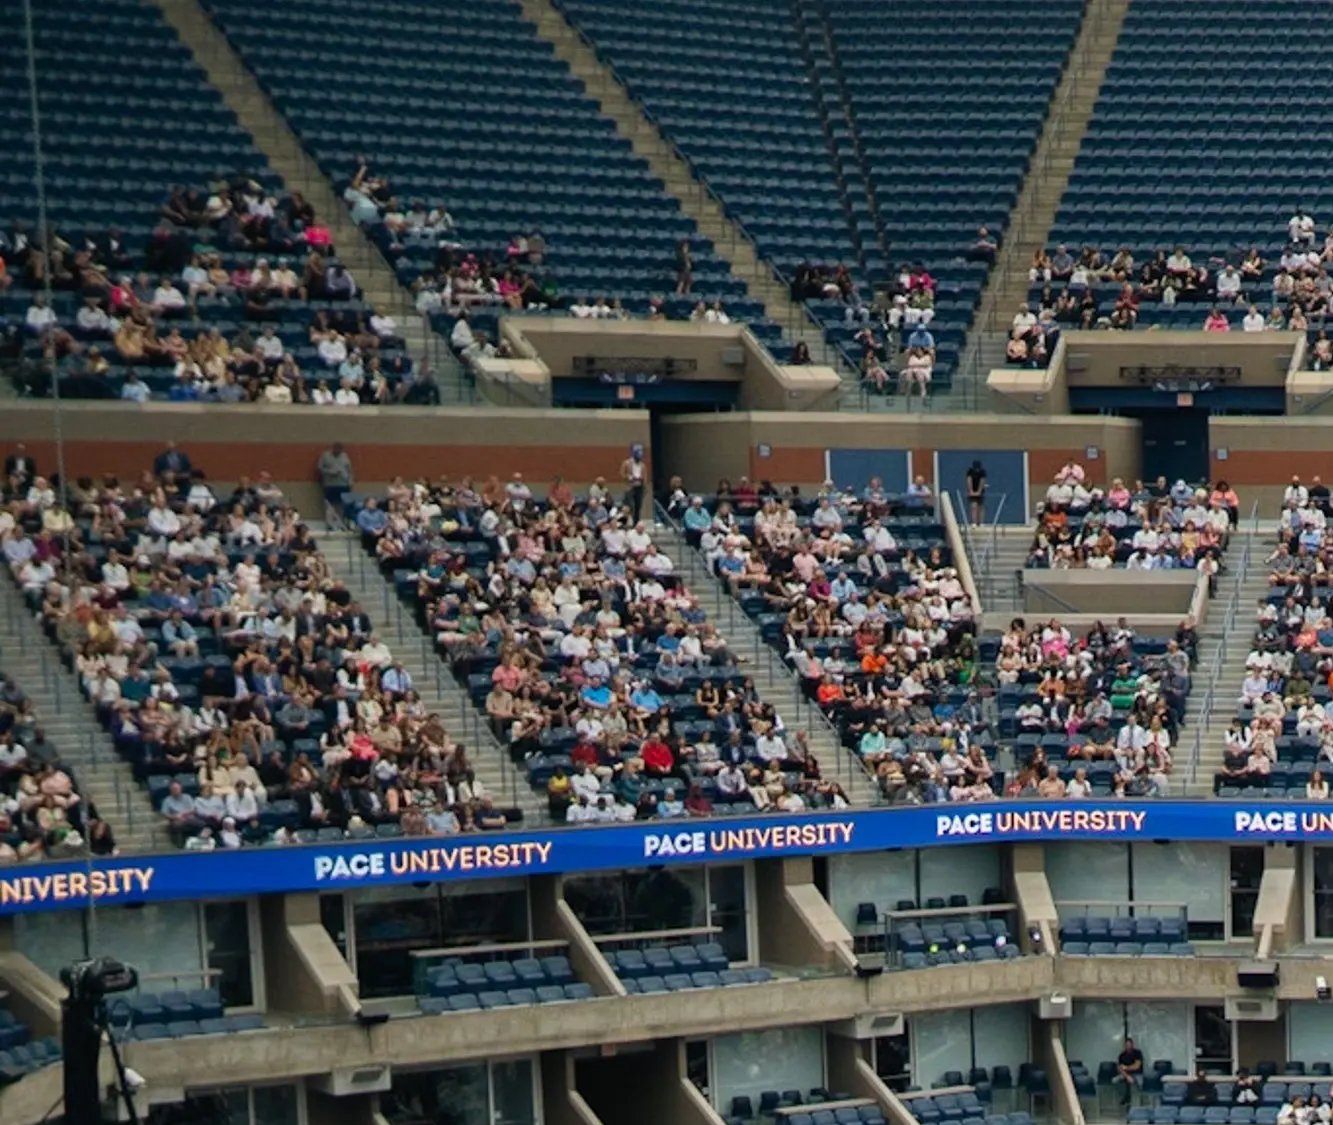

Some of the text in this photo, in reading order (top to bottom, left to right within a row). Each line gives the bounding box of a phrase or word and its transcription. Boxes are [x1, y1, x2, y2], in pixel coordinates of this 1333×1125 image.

[644, 821, 856, 857] PACE UNIVERSITY
[937, 810, 1146, 836] PACE UNIVERSITY
[1235, 811, 1297, 833] PACE
[315, 841, 552, 880] PACE UNIVERSITY
[0, 867, 154, 903] NIVERSITY
